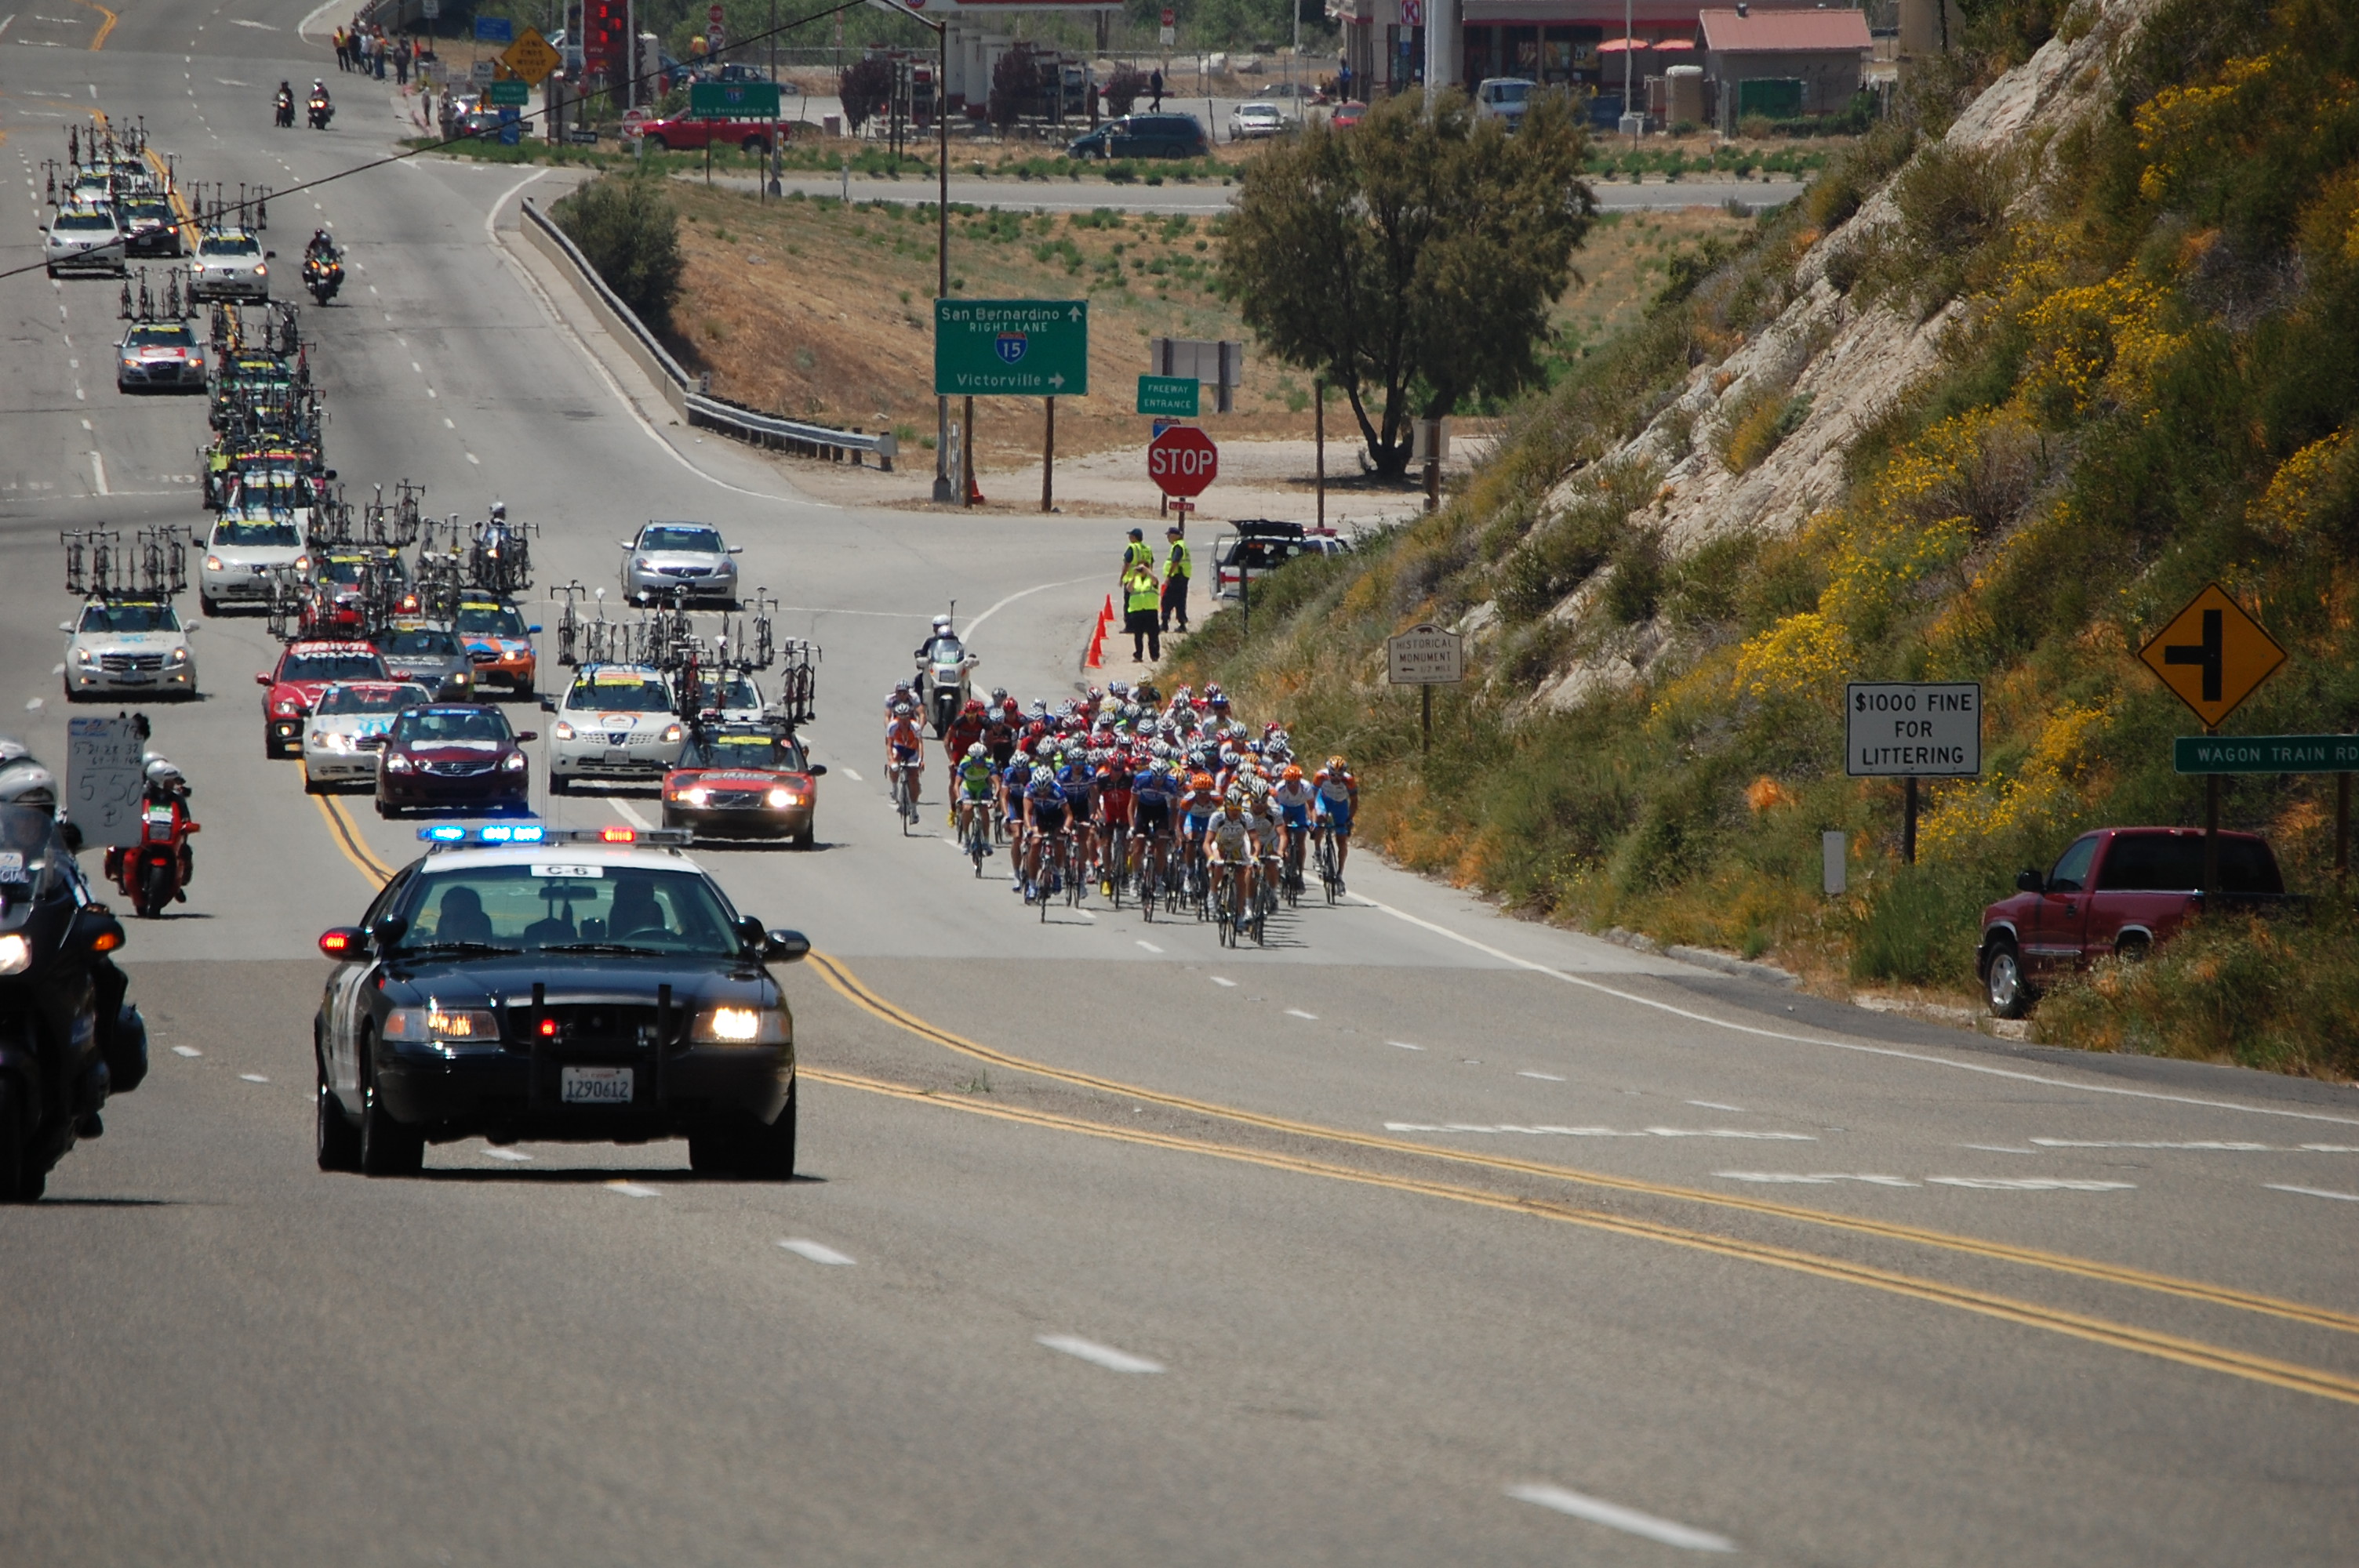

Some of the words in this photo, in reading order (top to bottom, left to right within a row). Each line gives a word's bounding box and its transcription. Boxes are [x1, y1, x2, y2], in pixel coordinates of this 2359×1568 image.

[1402, 1, 1419, 24] K
[696, 106, 713, 114] San
[715, 106, 761, 114] Bernardino
[942, 307, 970, 321] San
[976, 307, 1060, 321] Bernardino
[969, 322, 1008, 332] RIGHT
[1015, 322, 1048, 332] LANE
[1003, 342, 1021, 358] 15
[957, 373, 1041, 387] Victorville
[1147, 384, 1188, 394] FREEWAY
[1144, 398, 1191, 409] ENTRANCE
[1152, 448, 1213, 475] STOP
[1396, 638, 1452, 650] HISTORICAL
[295, 651, 375, 661] VOLVO
[1399, 652, 1451, 662] MONUMENT
[1856, 692, 1917, 713] $1000
[1928, 693, 1972, 711] FINE
[1895, 720, 1932, 738] FOR
[1863, 746, 1964, 766] LITTERING
[2197, 747, 2260, 762] WAGON
[2271, 746, 2325, 761] TRAIN
[2335, 746, 2359, 761] RD
[546, 865, 588, 876] C-6
[565, 1080, 629, 1098] 1290612
